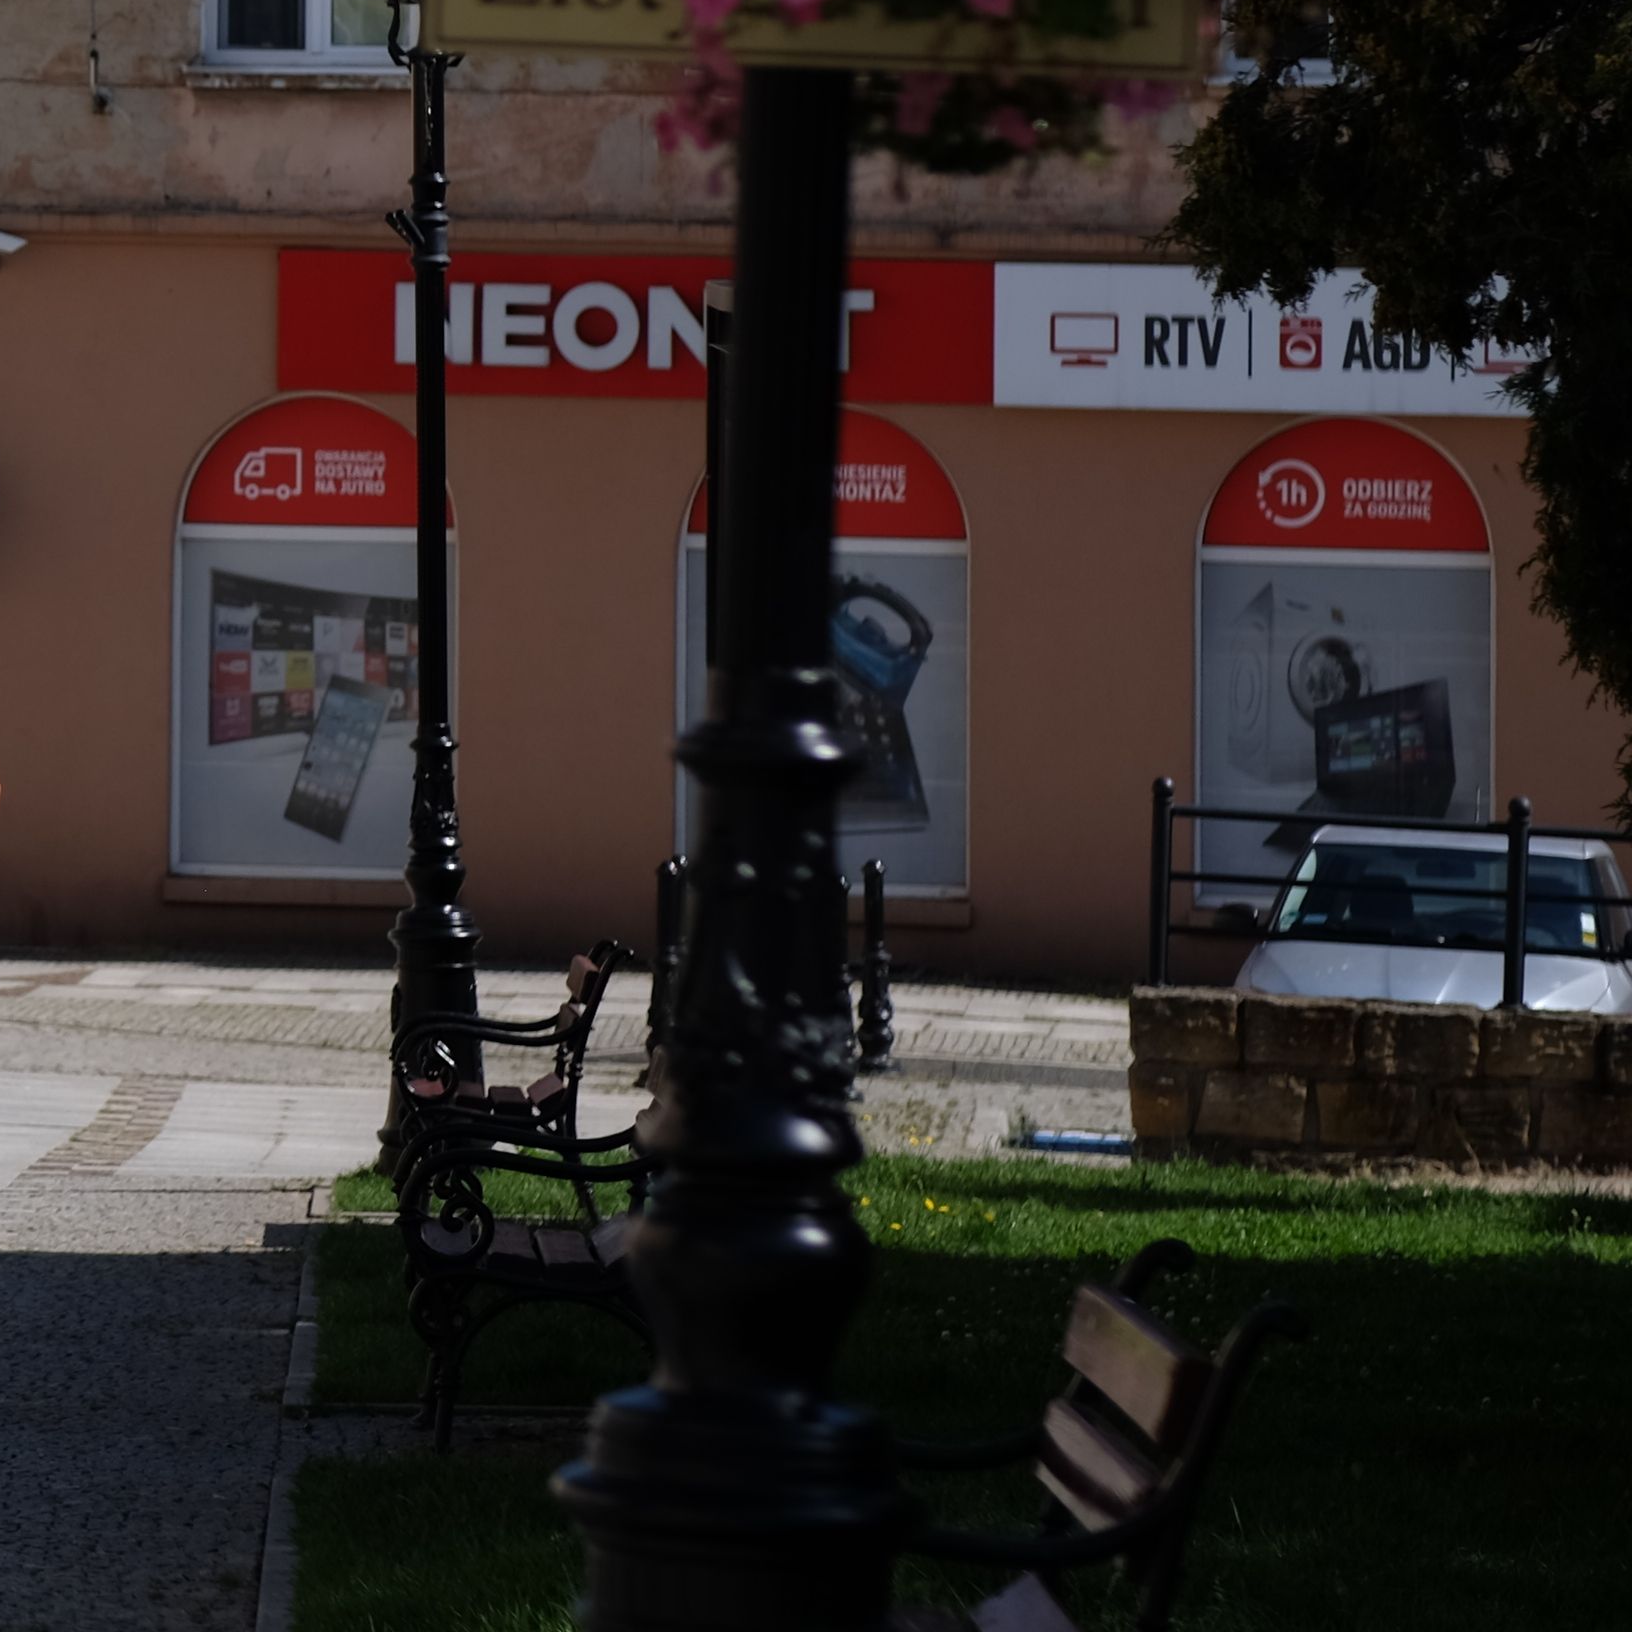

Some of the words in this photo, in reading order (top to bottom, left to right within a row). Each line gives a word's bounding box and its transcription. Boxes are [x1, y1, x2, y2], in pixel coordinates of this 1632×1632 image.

[394, 281, 875, 373] NEONT
[1143, 314, 1227, 368] RTV
[315, 463, 385, 480] DOSTAWY
[315, 480, 336, 496] NA
[340, 480, 386, 496] JUTRO
[1276, 478, 1307, 507] 1h
[1342, 478, 1433, 501] ODBIERZ
[1344, 501, 1364, 518] ZA
[1367, 501, 1432, 524] GODZINĘ
